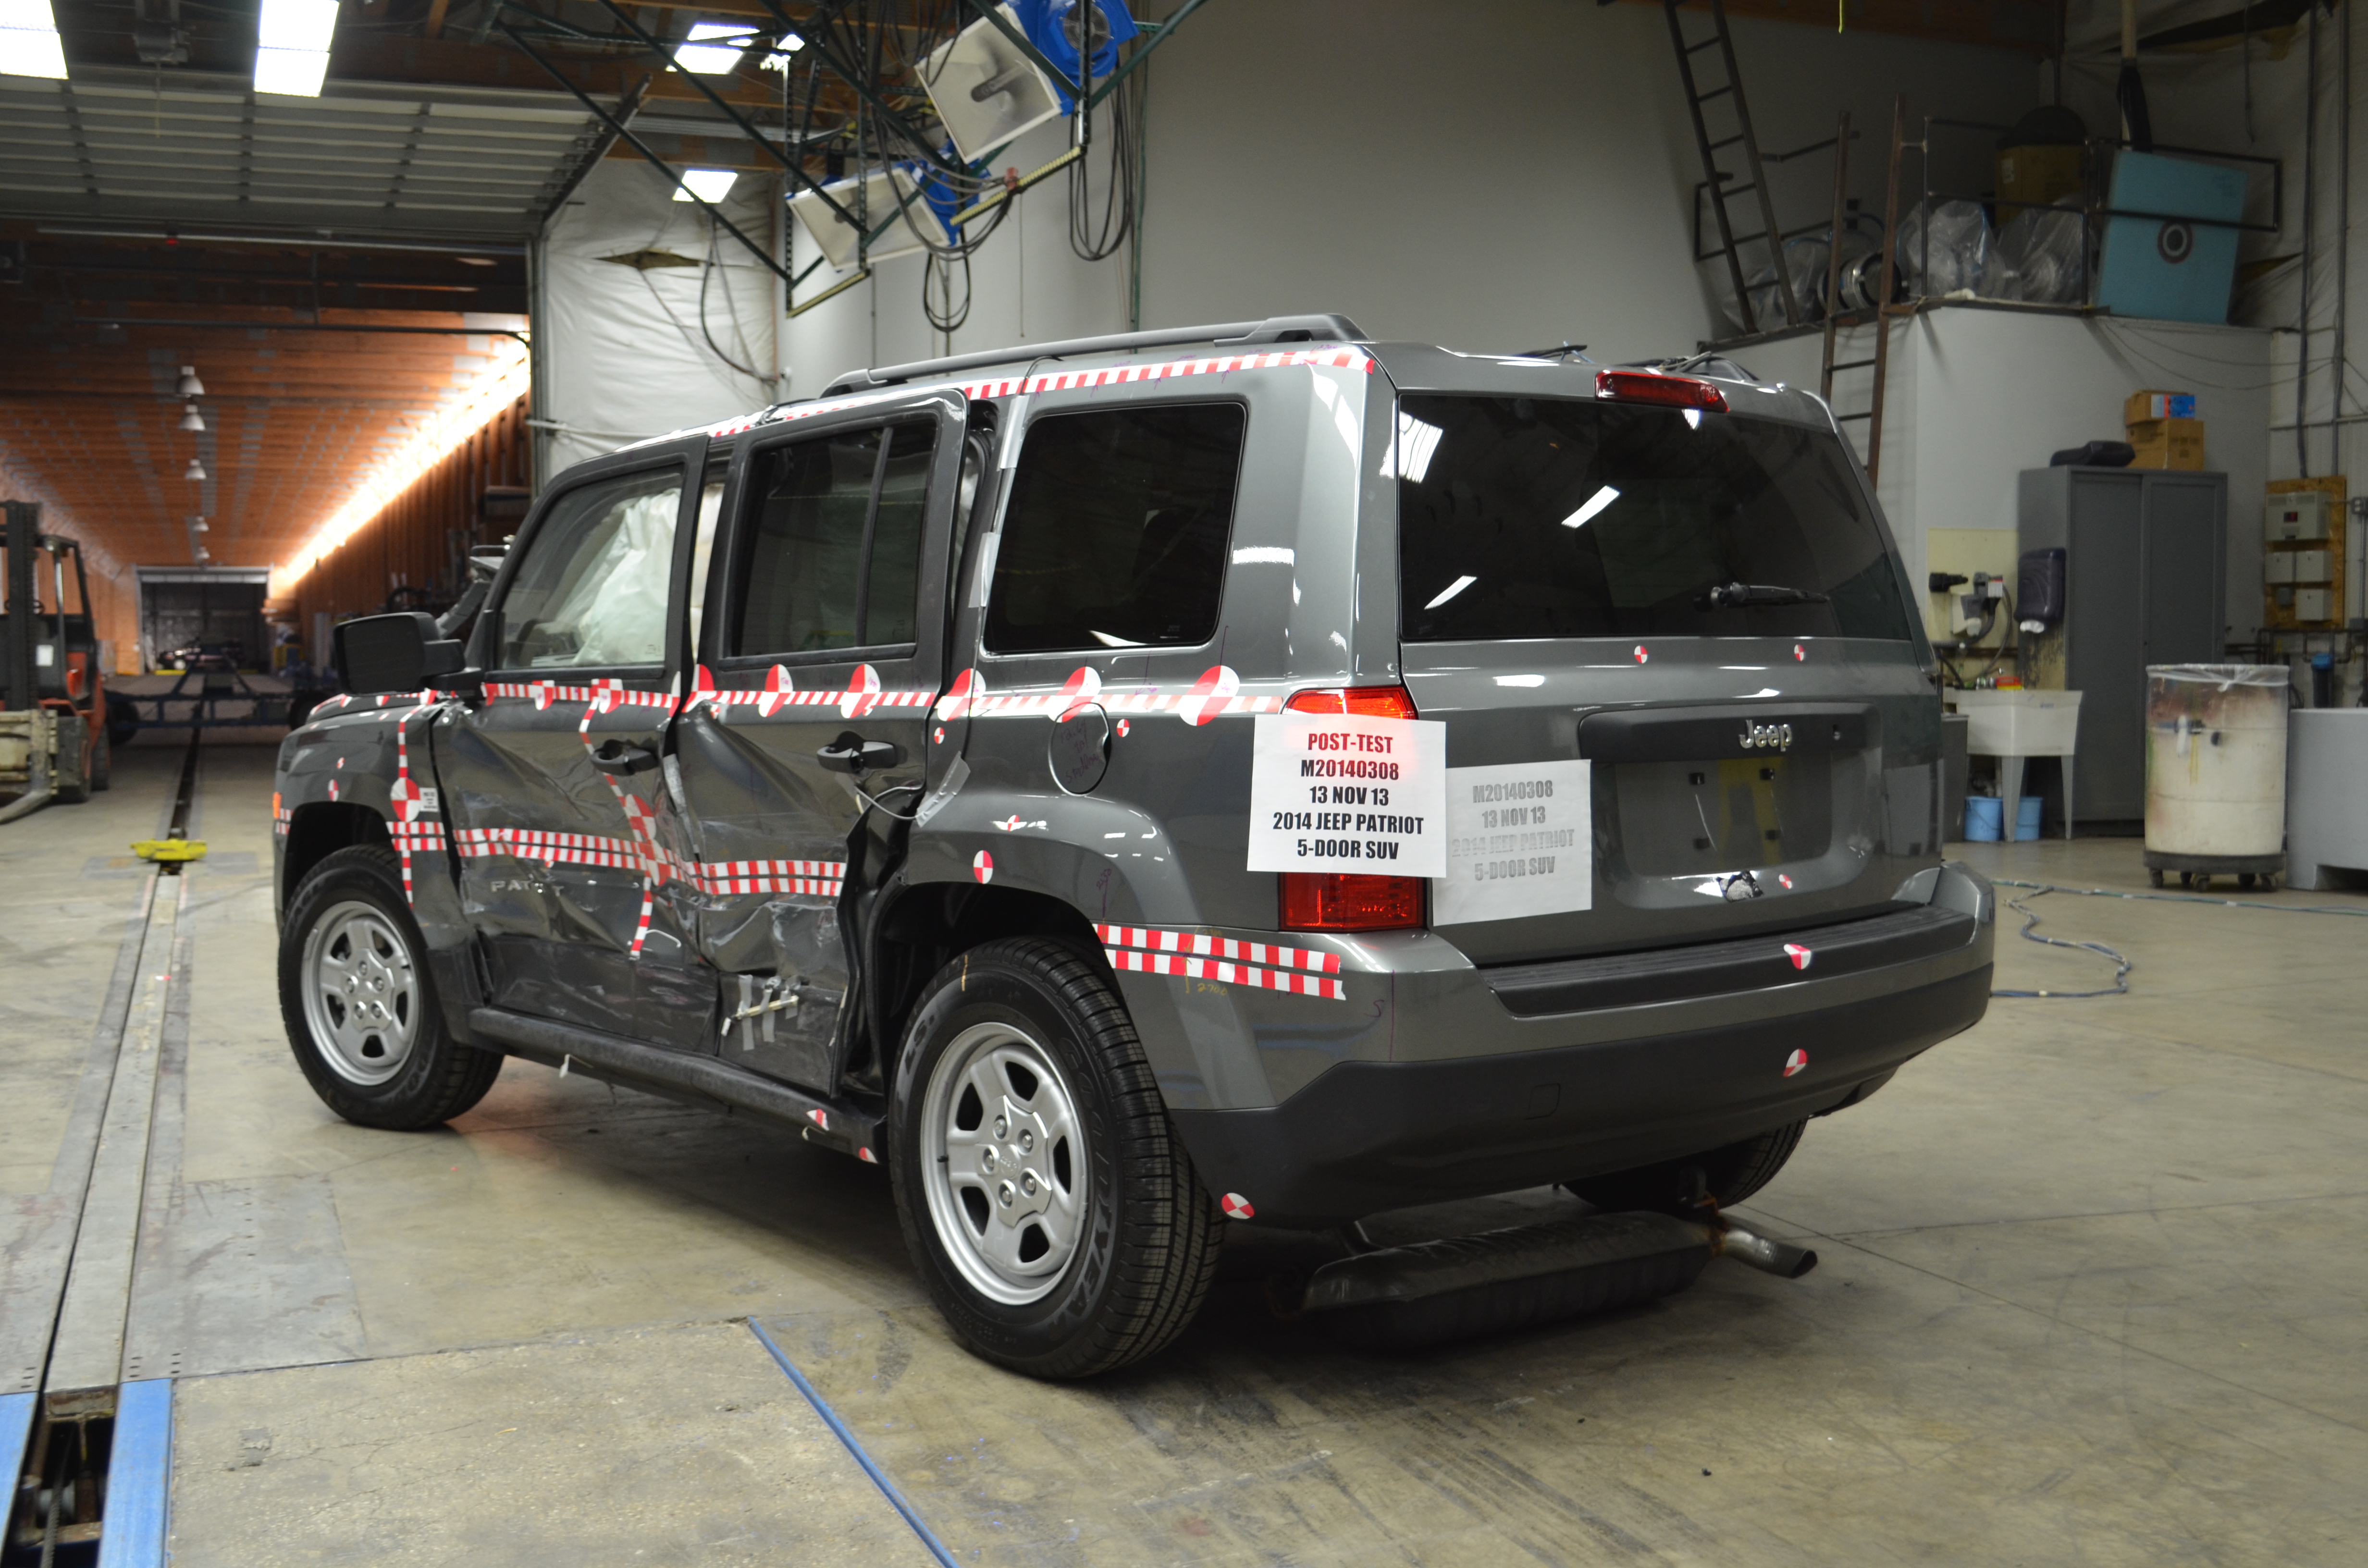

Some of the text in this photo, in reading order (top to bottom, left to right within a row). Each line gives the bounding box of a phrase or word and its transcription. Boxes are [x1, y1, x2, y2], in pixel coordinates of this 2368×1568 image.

[1308, 733, 1393, 753] POST-TEST
[1738, 719, 1793, 752] Jeep
[1301, 760, 1399, 781] M20140308
[1309, 786, 1389, 806] 13 NOV 13
[1473, 780, 1553, 803] M20140308
[1273, 812, 1424, 834] 2014 JEEP PATRIOT
[1481, 806, 1546, 828] 13 NOV 13
[1297, 839, 1399, 860] 5-DOOR SUV
[1451, 829, 1575, 857] 2014 JEEP PATRIOT
[1474, 856, 1555, 881] 5-DOOR SUV
